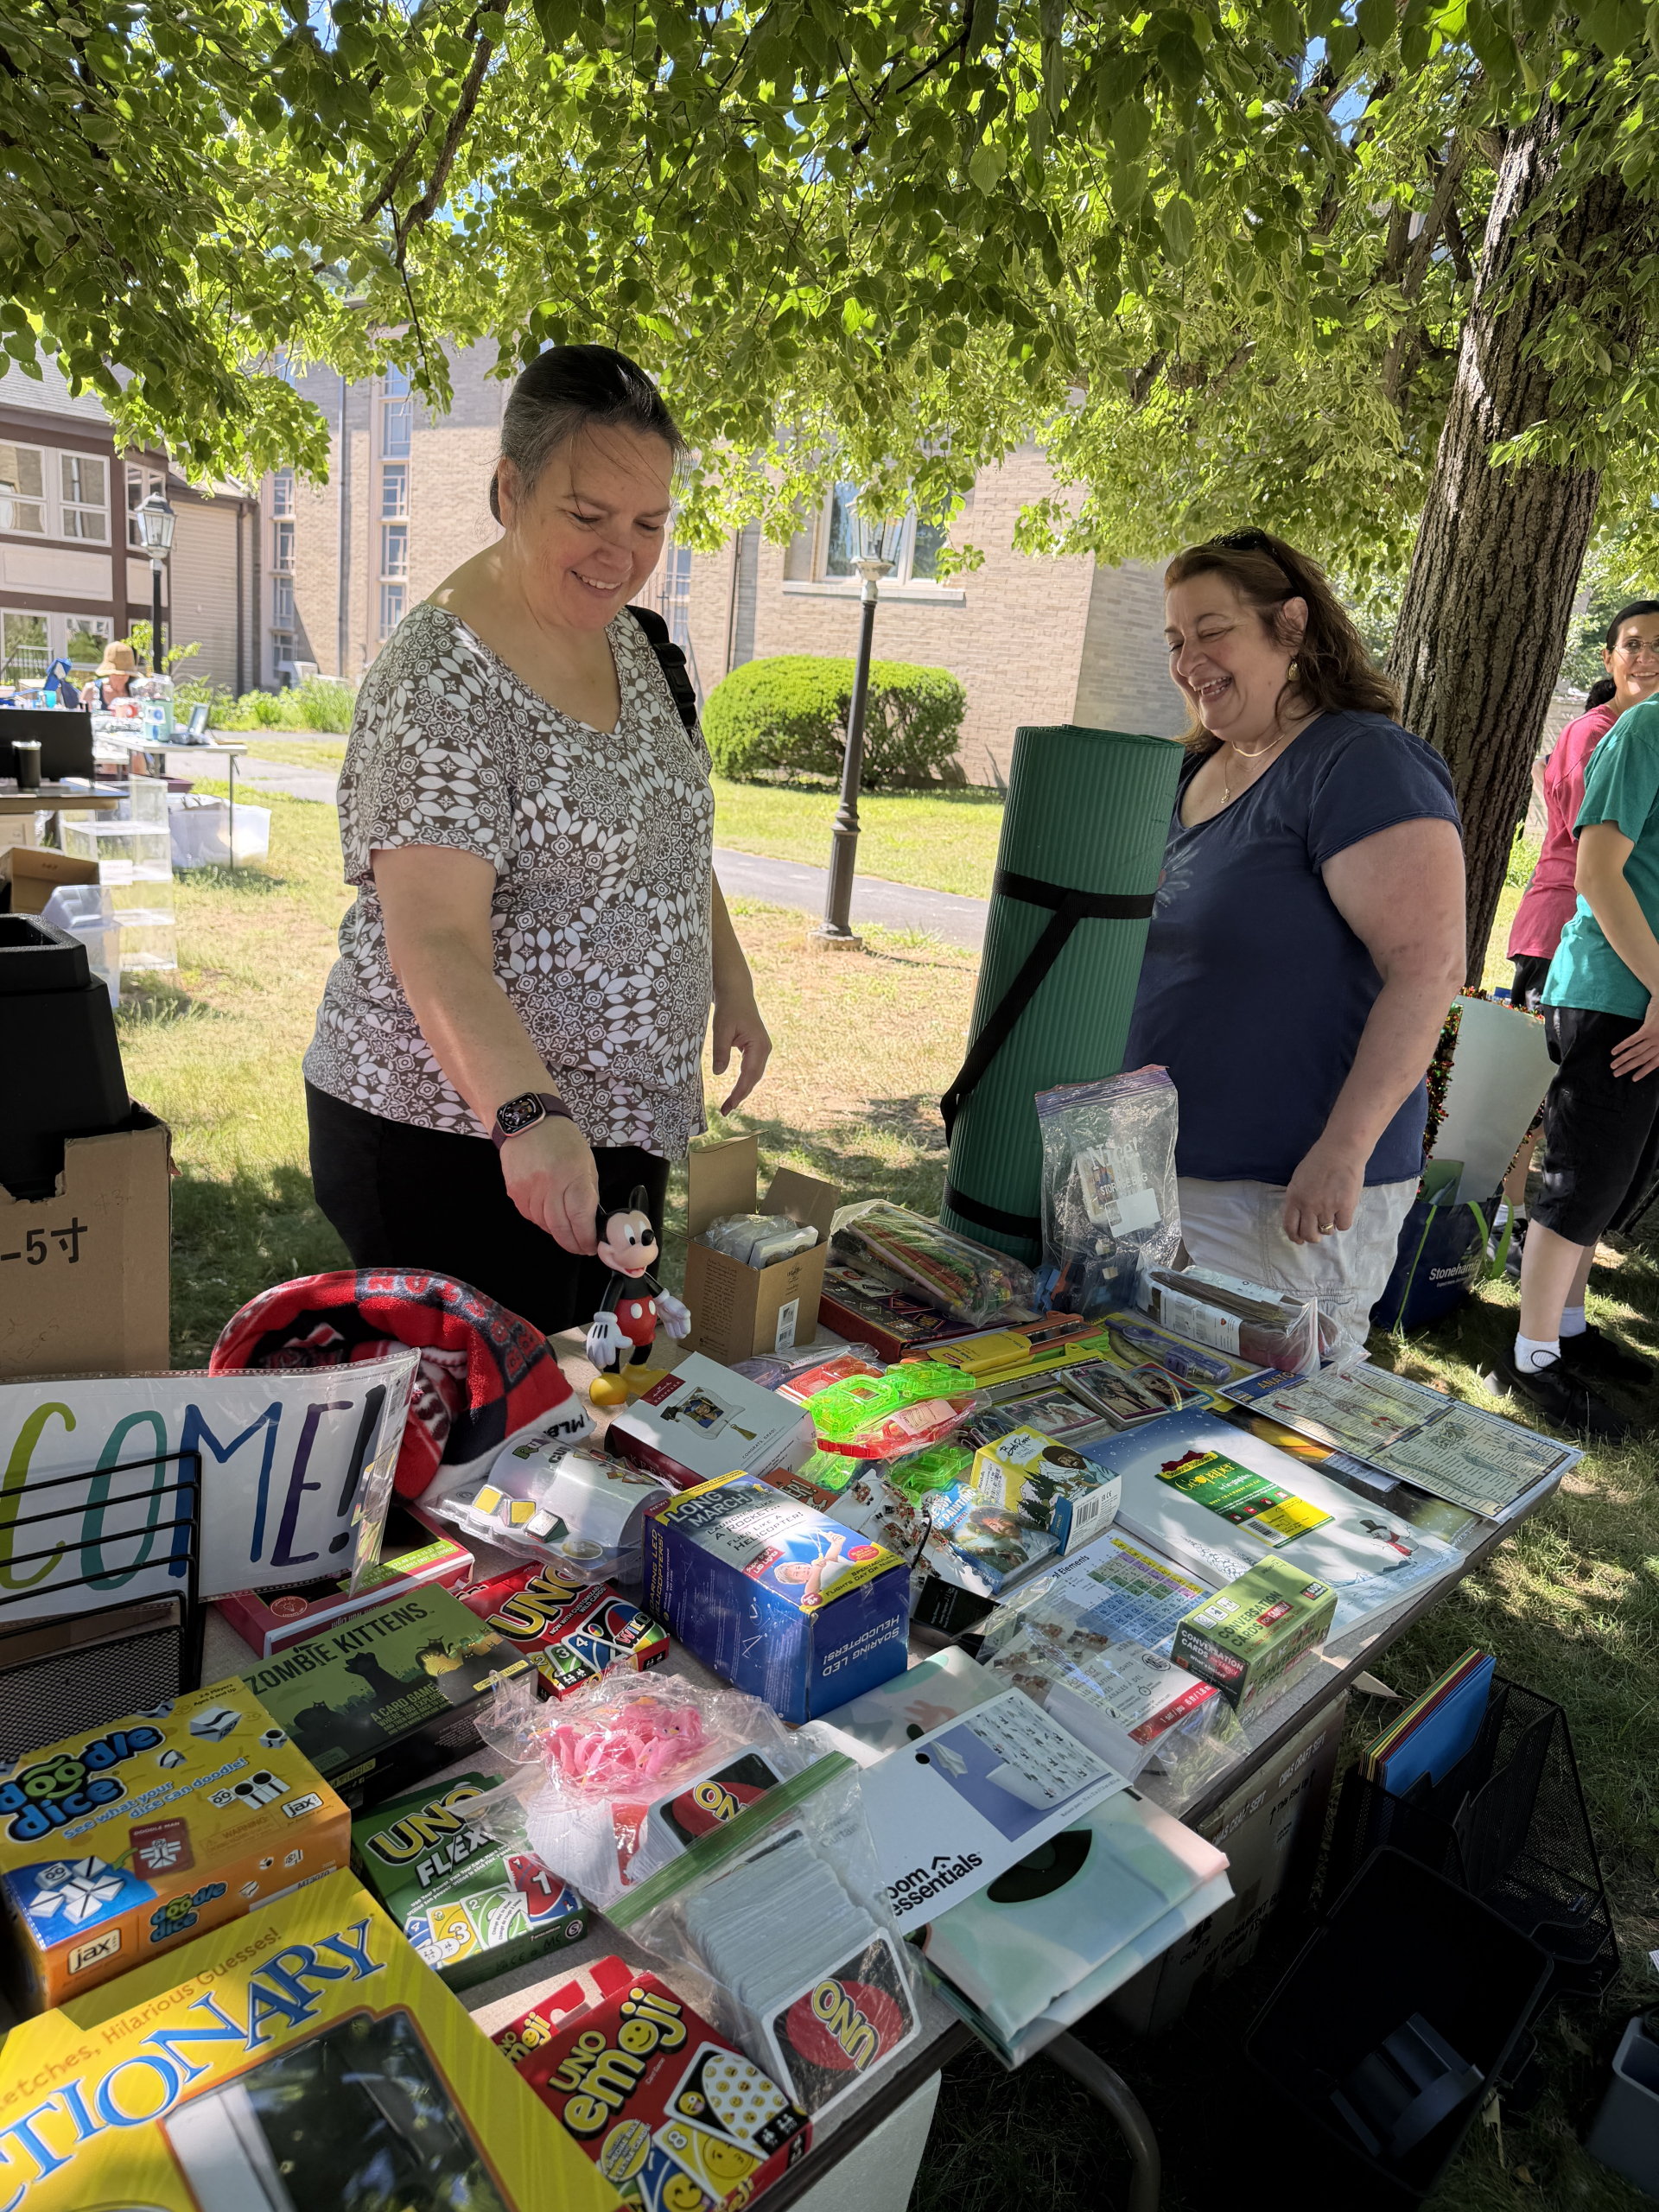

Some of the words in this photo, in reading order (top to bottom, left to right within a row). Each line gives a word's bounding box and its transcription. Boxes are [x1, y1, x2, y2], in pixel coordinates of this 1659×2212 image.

[1087, 1136, 1141, 1170] Nice!
[654, 1380, 681, 1403] KEEPSAKE
[1188, 1455, 1213, 1469] Stationery
[0, 1383, 387, 1592] COME!
[754, 1497, 775, 1510] LIKE
[649, 1500, 669, 1512] NEW!
[664, 1488, 724, 1527] LONG
[689, 1487, 753, 1528] MARCH
[943, 1484, 976, 1527] PAINTING
[714, 1529, 726, 1540] A
[732, 1510, 806, 1551] HELICOPTER!
[753, 1519, 774, 1533] LIKE
[824, 1579, 855, 1597] FLIGHTS
[854, 1571, 868, 1582] DAY
[879, 1555, 899, 1568] NIGHT
[850, 1553, 895, 1578] SPECTACULAR
[1052, 1571, 1061, 1580] of
[1058, 1551, 1090, 1578] Elements
[486, 1564, 589, 1641] UNO
[550, 1624, 561, 1635] NOW
[560, 1614, 573, 1625] WITH
[571, 1582, 604, 1614] CUSTOMIZABLE
[579, 1603, 590, 1614] WILD
[807, 1596, 820, 1606] 8+
[1218, 1591, 1283, 1639] CONVERSATION
[614, 1611, 652, 1644] WILD
[823, 1614, 899, 1666] HELICOPTERS!
[1231, 1624, 1264, 1646] CARDS
[1262, 1617, 1271, 1626] FOR
[1269, 1602, 1291, 1619] FAMILY
[243, 1641, 340, 1695] ZOMBIE
[334, 1602, 430, 1655] KITTENS
[556, 1648, 569, 1659] 3
[576, 1637, 588, 1648] 4
[852, 1627, 899, 1661] SOARING
[1181, 1638, 1209, 1658] CARDS
[1181, 1630, 1243, 1671] CONVERSATION
[1259, 1629, 1319, 1682] CONVERSATION
[534, 1656, 546, 1667] 2
[822, 1656, 849, 1677] LED
[1190, 1654, 1207, 1668] What's
[210, 1682, 233, 1694] Players
[1081, 1688, 1091, 1698] LED
[1116, 1660, 1134, 1675] LIGHTS
[1132, 1674, 1143, 1683] DEL
[193, 1697, 210, 1707] Ages
[370, 1710, 382, 1723] A
[378, 1696, 410, 1719] CARD
[406, 1681, 437, 1704] GAME
[378, 1711, 404, 1728] WHERE
[401, 1703, 417, 1716] YOU
[415, 1689, 444, 1709] EXPLODE
[384, 1722, 395, 1732] AND
[393, 1716, 408, 1726] THEN
[406, 1710, 419, 1720] COME
[418, 1703, 431, 1713] BACK
[1175, 1703, 1187, 1715] jeu
[1196, 1686, 1208, 1698] 1.8
[0, 1725, 166, 1815] doodle
[318, 1756, 344, 1770] KITTENS
[129, 1798, 162, 1820] dice
[163, 1783, 194, 1803] can
[192, 1757, 249, 1789] doodle!
[1276, 1801, 1287, 1814] This
[1288, 1789, 1299, 1802] End
[1300, 1777, 1310, 1794] Up
[15, 1777, 121, 1840] dice
[63, 1819, 94, 1840] See
[96, 1799, 137, 1824] what
[137, 1780, 174, 1810] your
[284, 1797, 313, 1818] jax
[133, 1824, 163, 1837] DOODLE
[165, 1821, 181, 1830] MAN
[224, 1816, 271, 1839] WARNING:
[366, 1785, 488, 1866] UNO
[406, 1903, 425, 1916] Utilise
[424, 1897, 435, 1905] ton
[433, 1884, 454, 1899] pouvoir.
[453, 1873, 469, 1886] Utilise
[485, 1855, 498, 1866] Flex.
[410, 1898, 422, 1907] Use
[421, 1891, 433, 1900] Your
[433, 1879, 450, 1893] Power.
[449, 1872, 461, 1882] Flex
[461, 1866, 473, 1875] Your
[472, 1857, 485, 1868] Card.
[532, 1870, 552, 1894] 1
[887, 1866, 930, 1899] oom
[892, 1850, 983, 1917] essentials
[149, 1881, 227, 1929] doodle
[434, 1910, 444, 1921] 3
[468, 1899, 480, 1910] 2
[149, 1910, 199, 1942] dice
[411, 1922, 421, 1931] 4
[448, 1922, 472, 1944] 3
[1203, 1948, 1218, 1967] DIY
[1220, 1901, 1269, 1950] ORNAMENT
[74, 1934, 111, 1968] jax
[1180, 1936, 1210, 1966] CRAFTS
[100, 1981, 195, 2046] Hilarious
[196, 1927, 283, 1986] Guesses!
[811, 1979, 880, 2073] UNO
[0, 1918, 386, 2209] TIONARY
[548, 2031, 607, 2092] UNO
[563, 1986, 687, 2139] emoji
[645, 2069, 658, 2085] Card
[655, 2056, 665, 2071] Game
[602, 2138, 633, 2170] SPECIAL
[622, 2117, 644, 2139] RULE
[613, 2150, 640, 2177] EXTRA
[628, 2122, 657, 2151] CARDS!
[666, 2129, 688, 2151] 8
